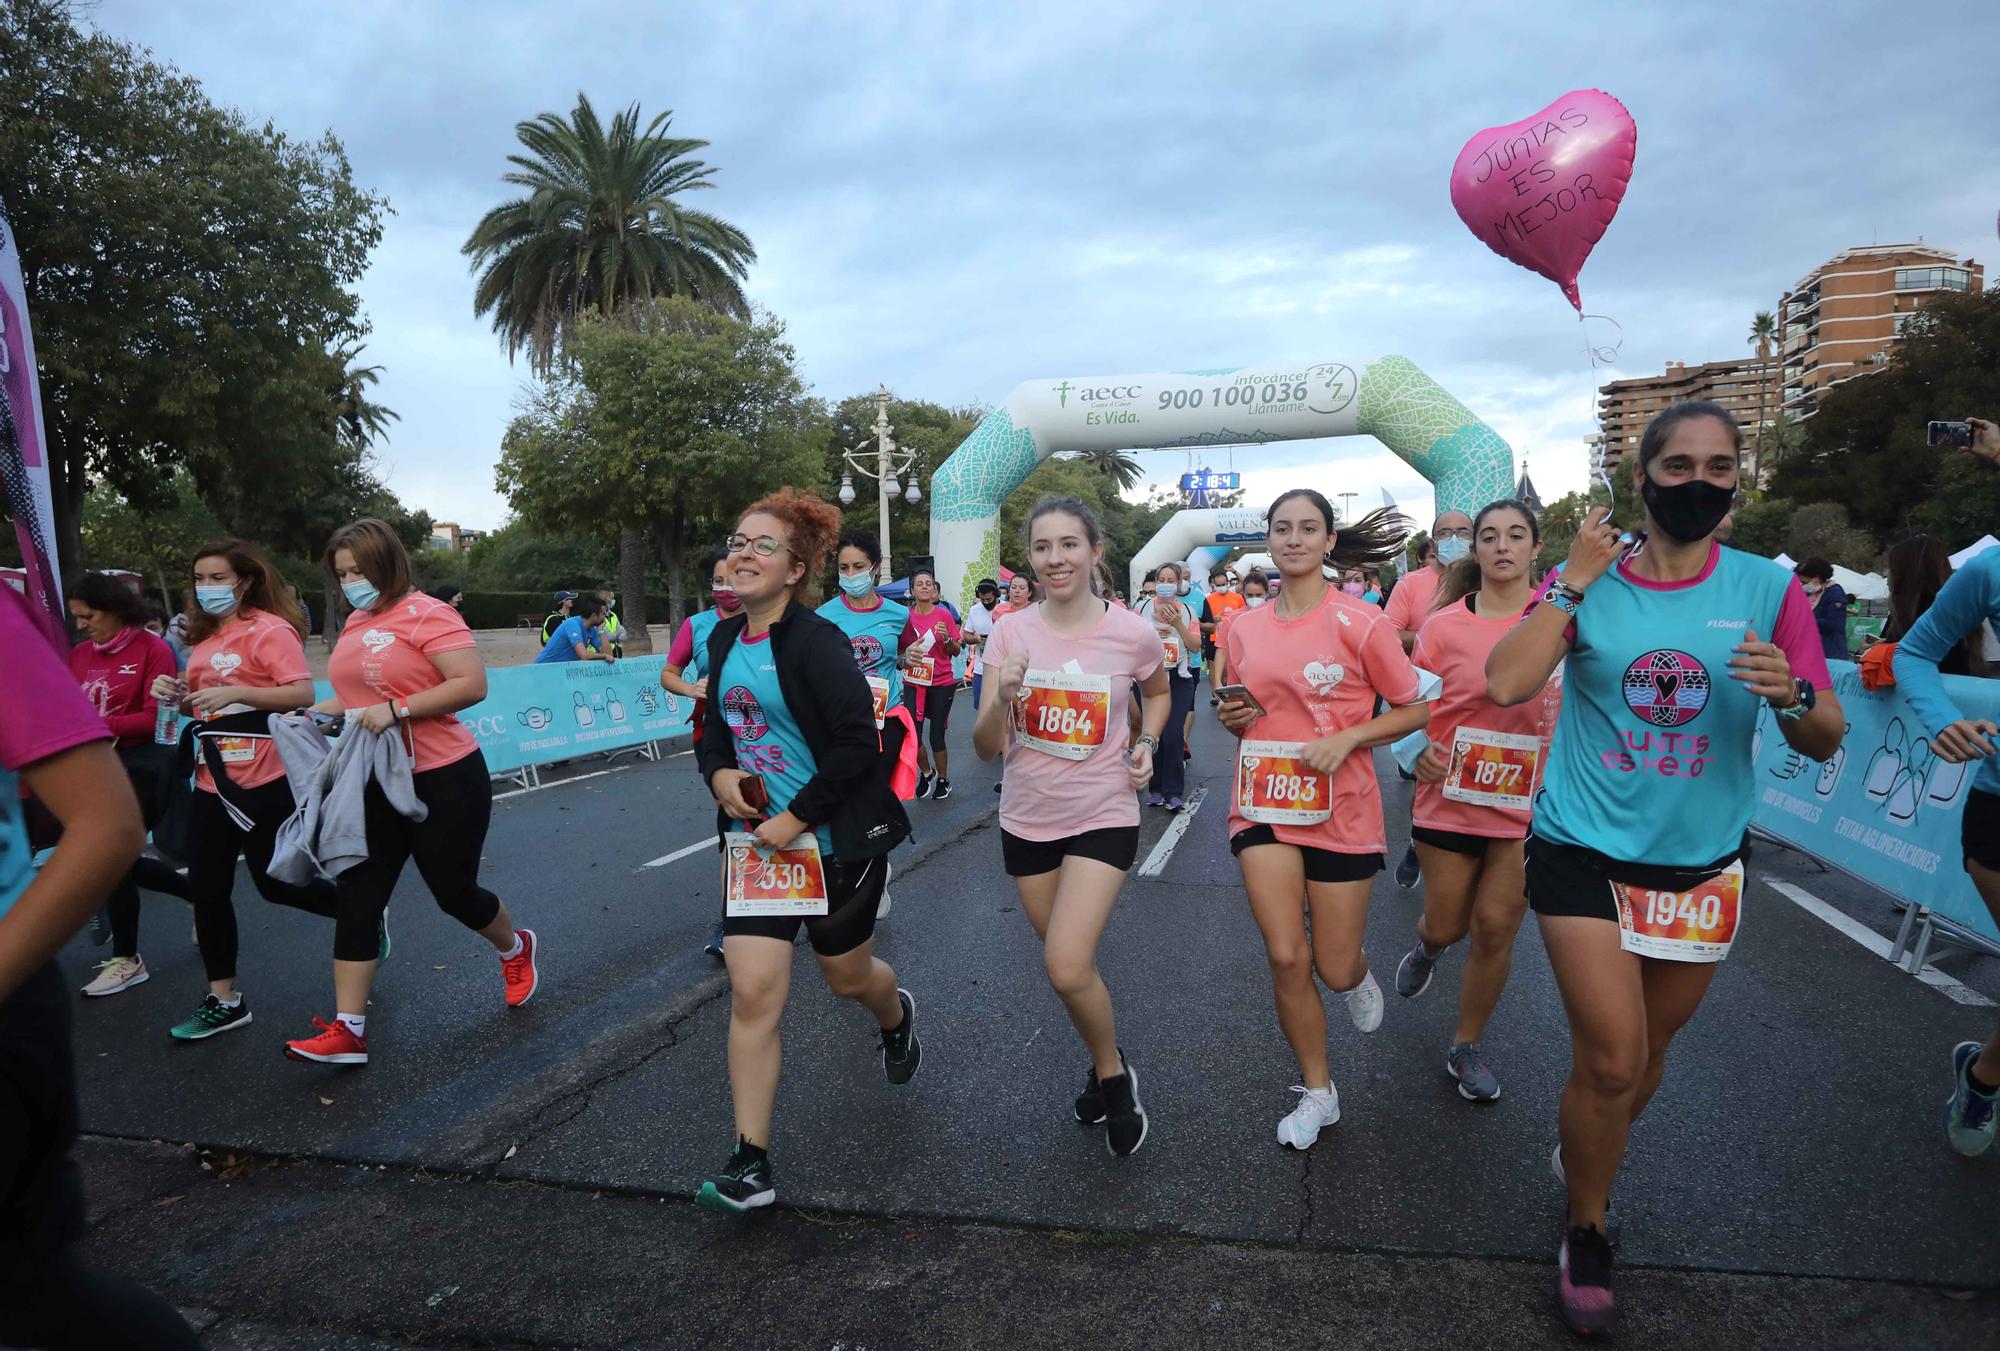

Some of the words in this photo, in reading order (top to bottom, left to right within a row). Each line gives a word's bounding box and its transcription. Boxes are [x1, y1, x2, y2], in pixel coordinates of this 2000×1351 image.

[1473, 107, 1588, 183] JUNTAS
[1508, 160, 1556, 197] ES
[1493, 174, 1604, 247] MEJOR
[1234, 372, 1310, 386] infocáncer
[1316, 366, 1334, 377] 24
[1080, 385, 1143, 402] aecc
[1158, 388, 1204, 411] 900
[1212, 385, 1256, 408] 100
[1261, 381, 1308, 405] 036
[1331, 383, 1344, 400] 7
[1086, 412, 1101, 425] Es
[1105, 410, 1141, 425] Vida.
[1308, 673, 1342, 682] aecc
[1038, 705, 1092, 737] 1864
[1474, 759, 1523, 786] 1877
[1266, 774, 1317, 802] 1883
[1861, 826, 1942, 875] AGLOMERACIONES
[760, 863, 806, 890] 330
[1645, 891, 1721, 930] 1940
